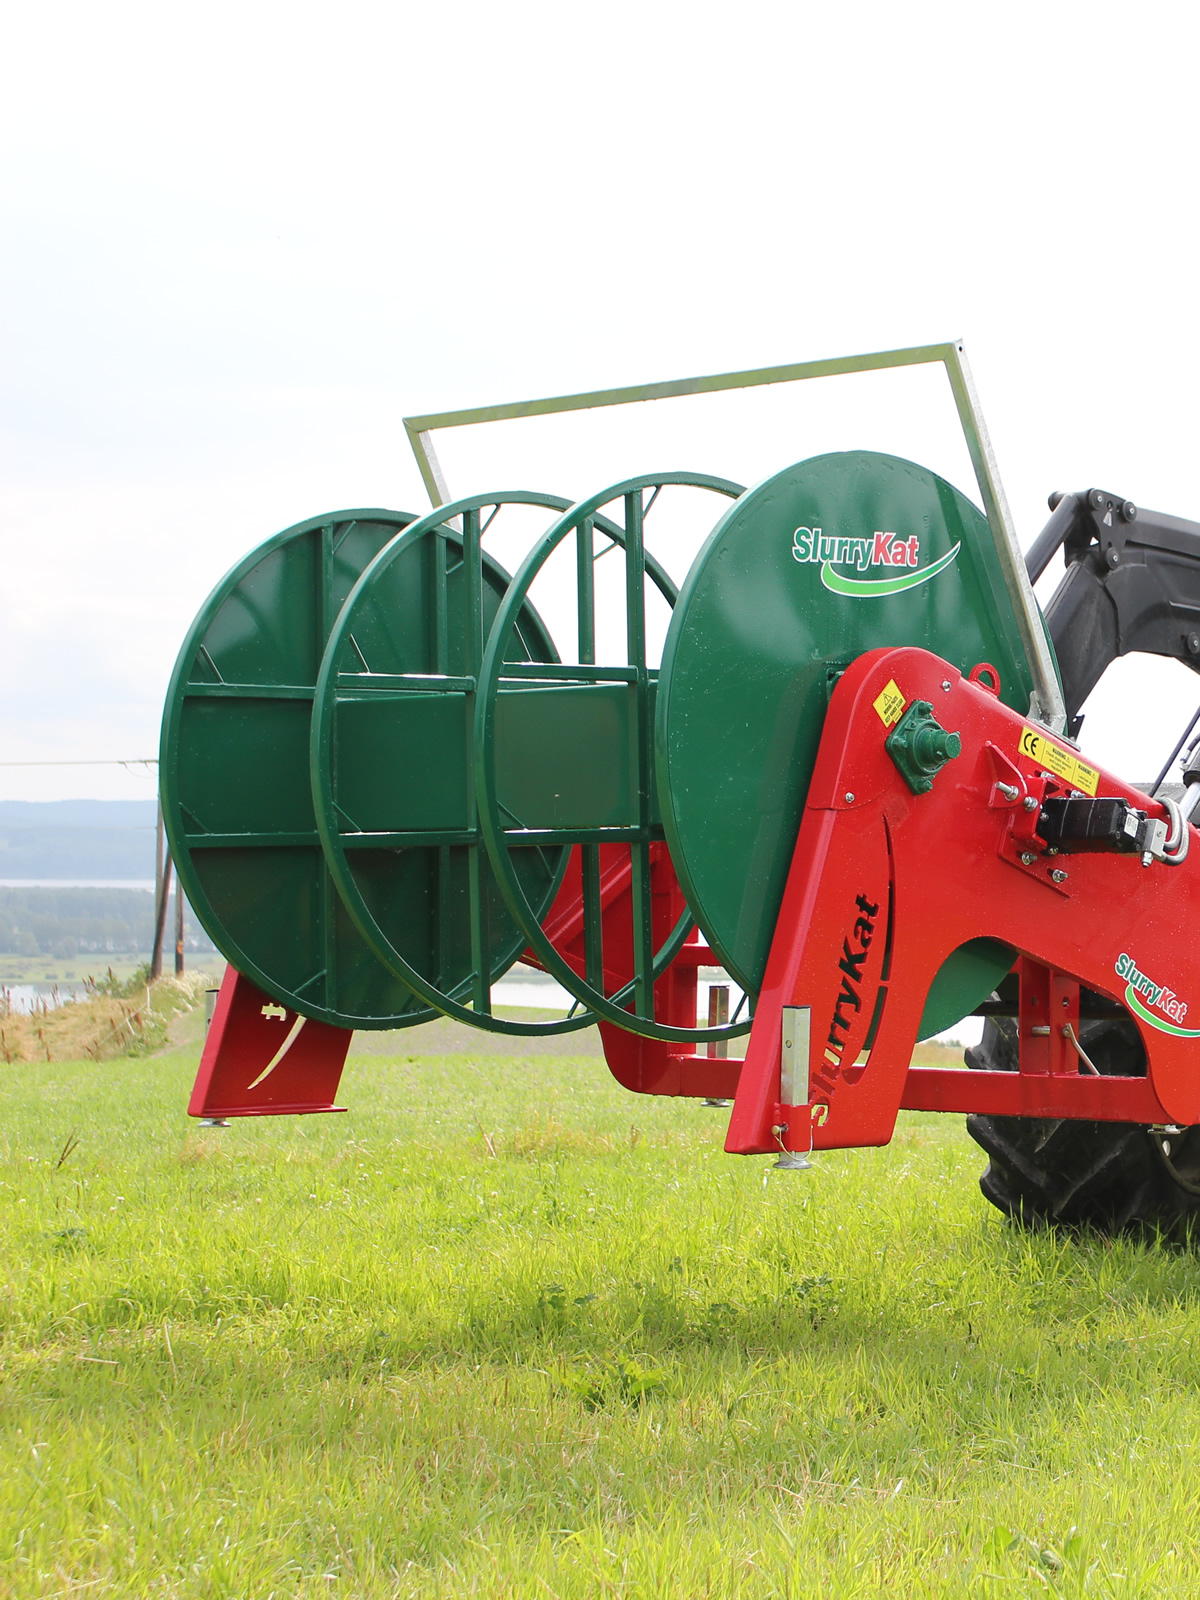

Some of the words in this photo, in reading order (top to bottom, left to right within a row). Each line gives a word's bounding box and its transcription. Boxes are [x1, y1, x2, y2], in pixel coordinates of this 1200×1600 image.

[792, 526, 919, 571] SlurryKat
[1023, 732, 1040, 757] CE
[1115, 952, 1188, 1024] SlurryKat
